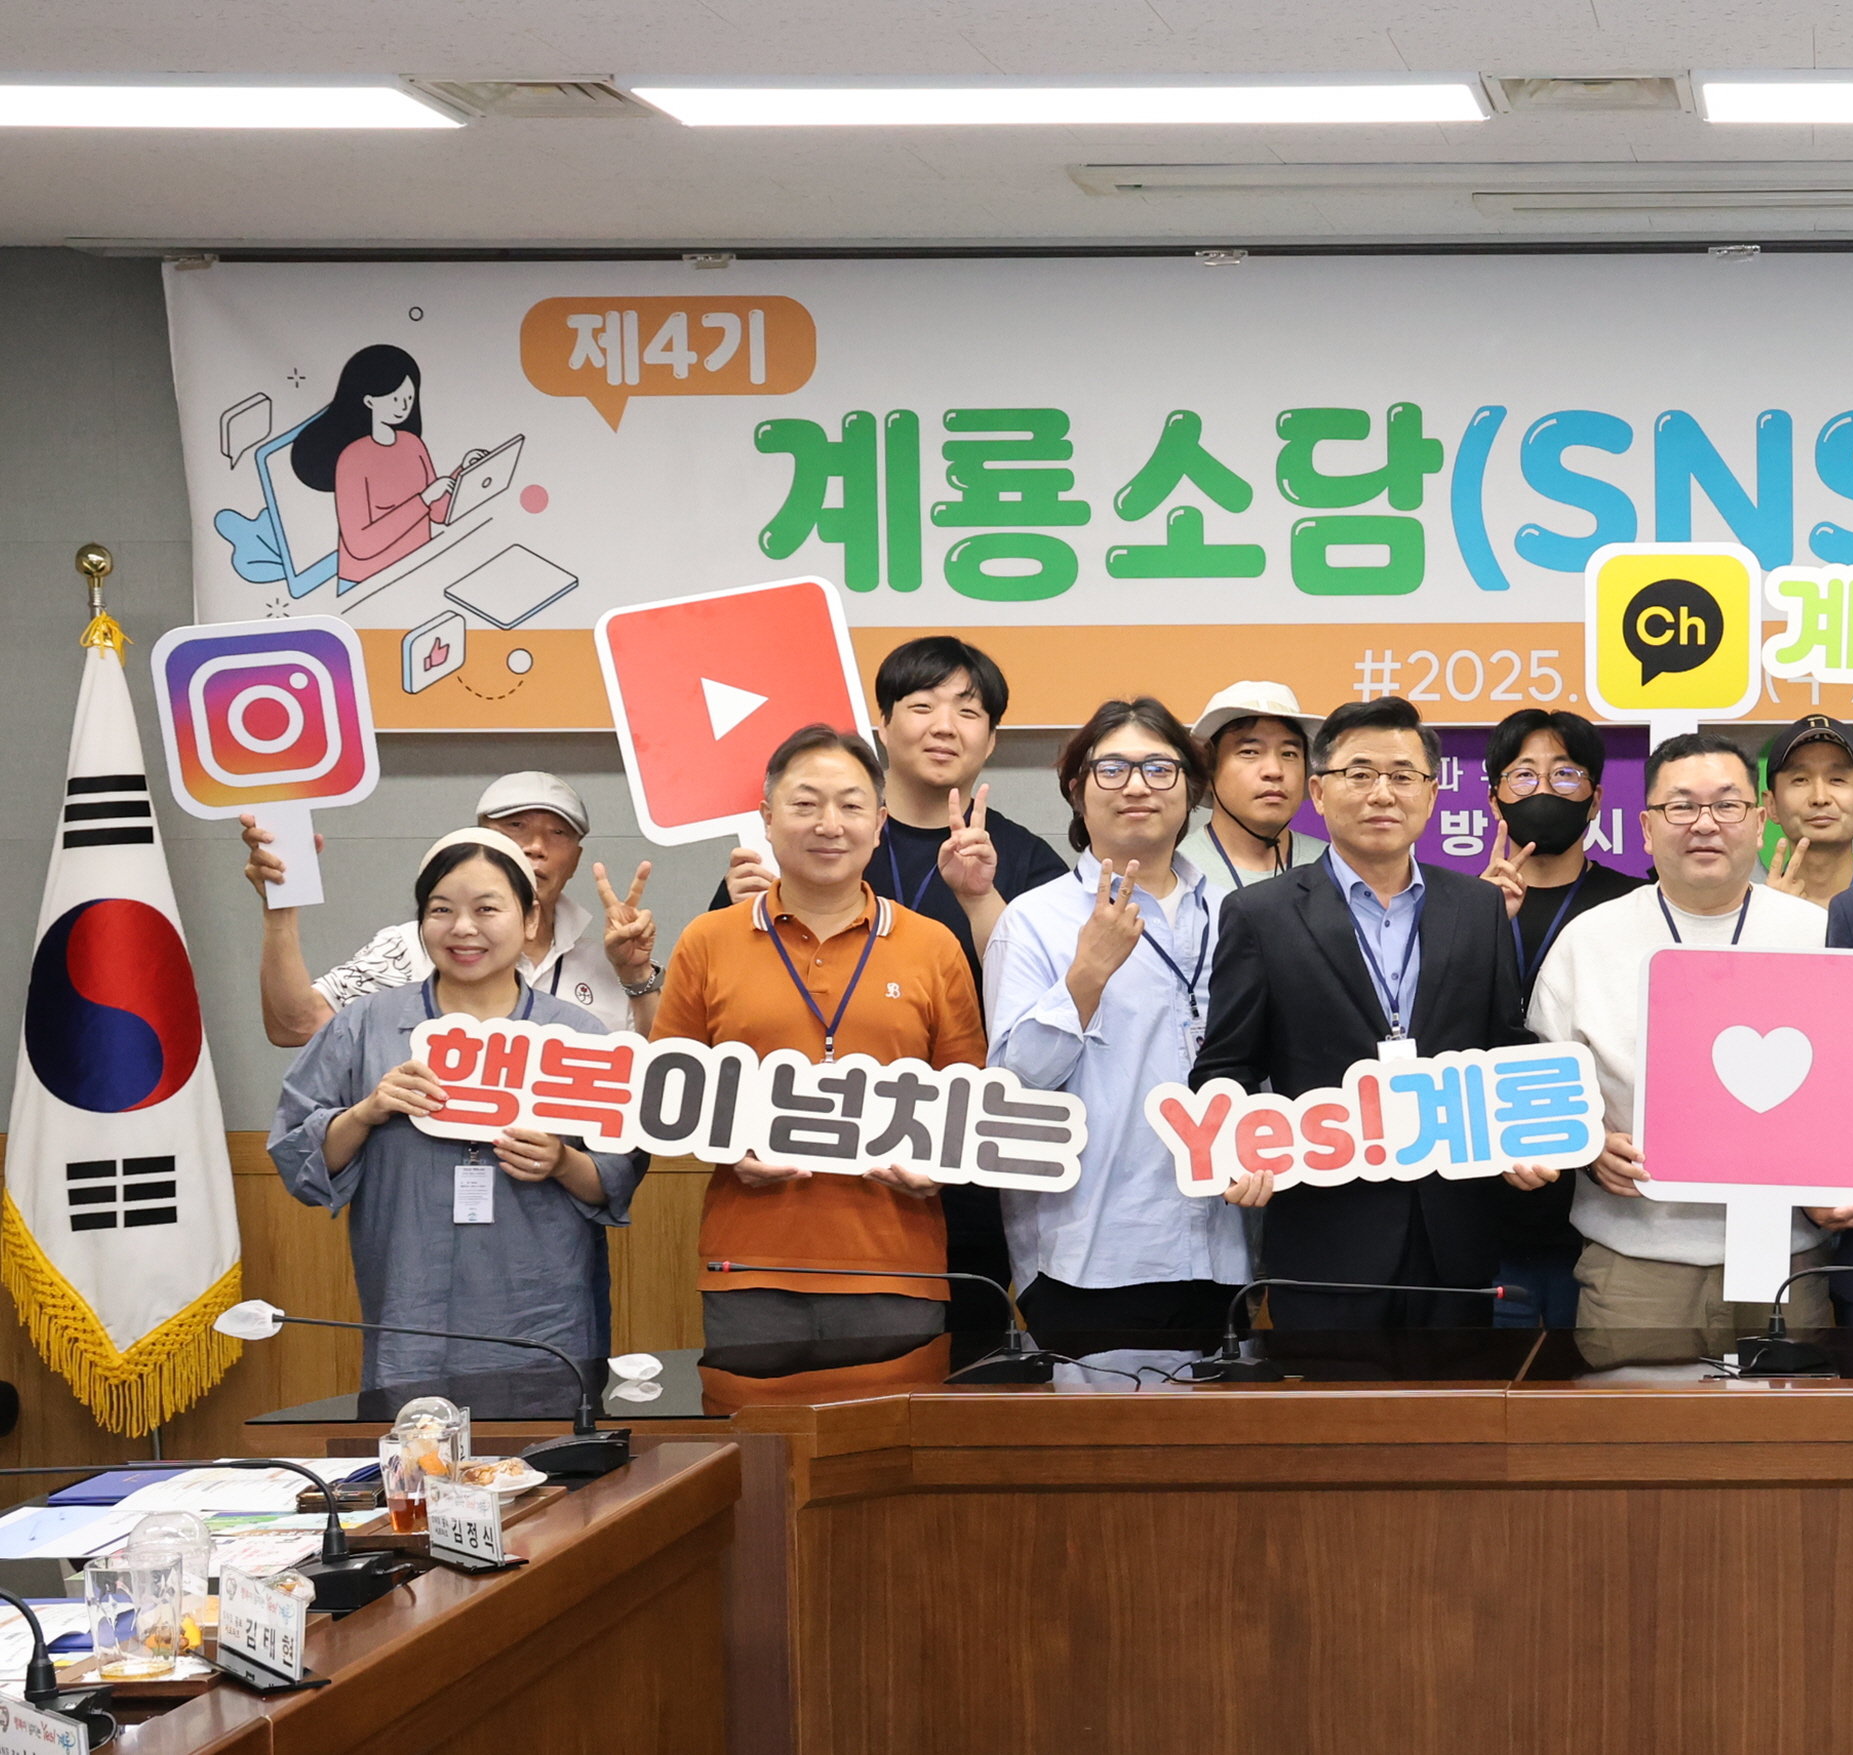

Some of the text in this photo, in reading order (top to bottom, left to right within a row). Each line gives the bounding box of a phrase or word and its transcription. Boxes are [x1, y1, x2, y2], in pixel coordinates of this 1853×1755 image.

[566, 310, 766, 386] 제4기
[1636, 605, 1707, 646] Ch
[426, 1026, 1072, 1179] 행복이 넘치는
[1159, 1055, 1591, 1183] Yes!계룡
[451, 1518, 495, 1555] 김정식
